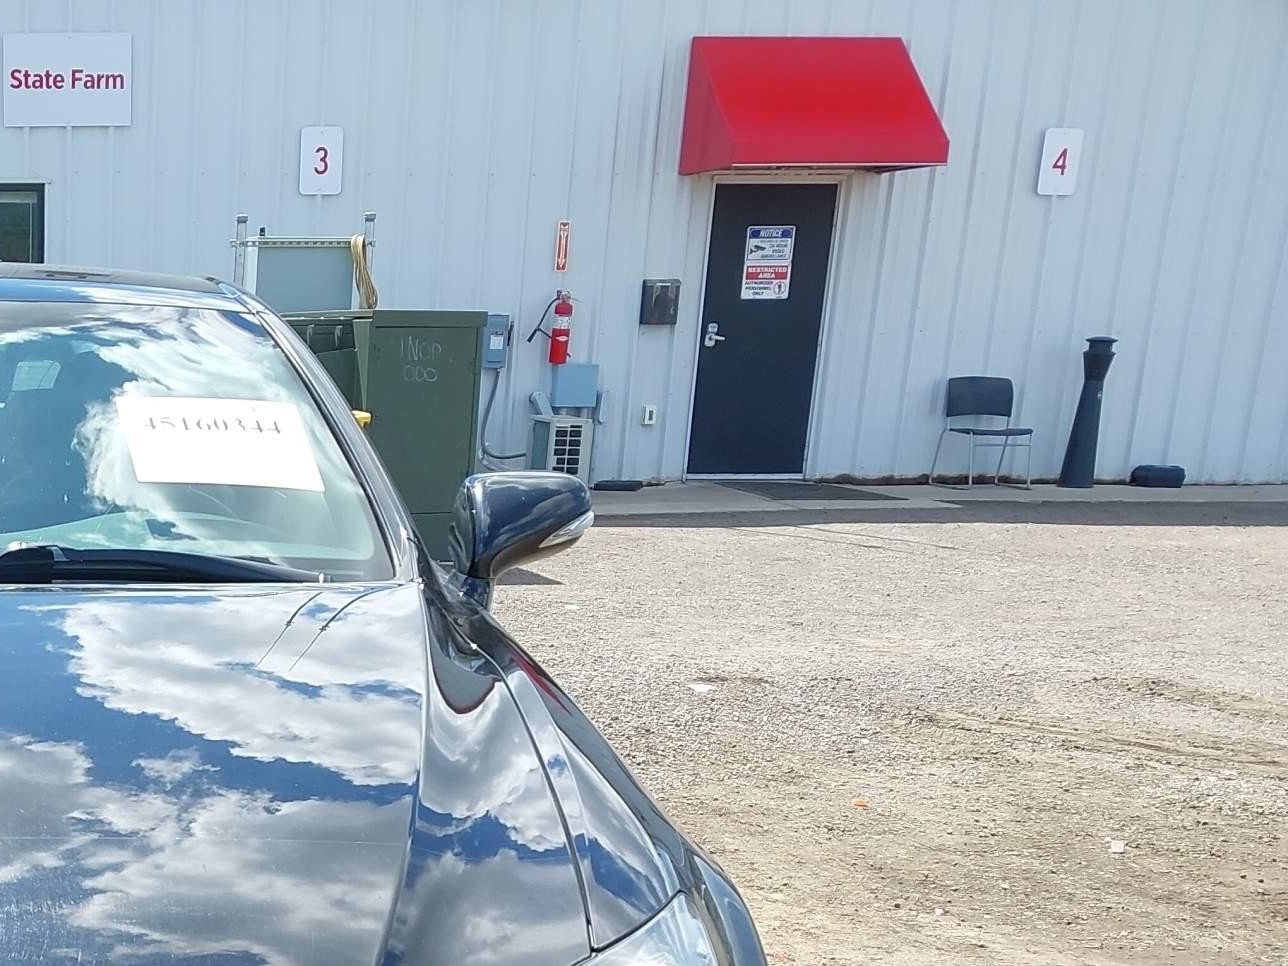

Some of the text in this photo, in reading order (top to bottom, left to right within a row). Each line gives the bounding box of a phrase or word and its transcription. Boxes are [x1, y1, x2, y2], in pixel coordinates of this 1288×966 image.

[9, 68, 125, 90] State Farm
[313, 146, 329, 175] 3
[1052, 147, 1068, 176] 4
[759, 229, 784, 238] NOTICE
